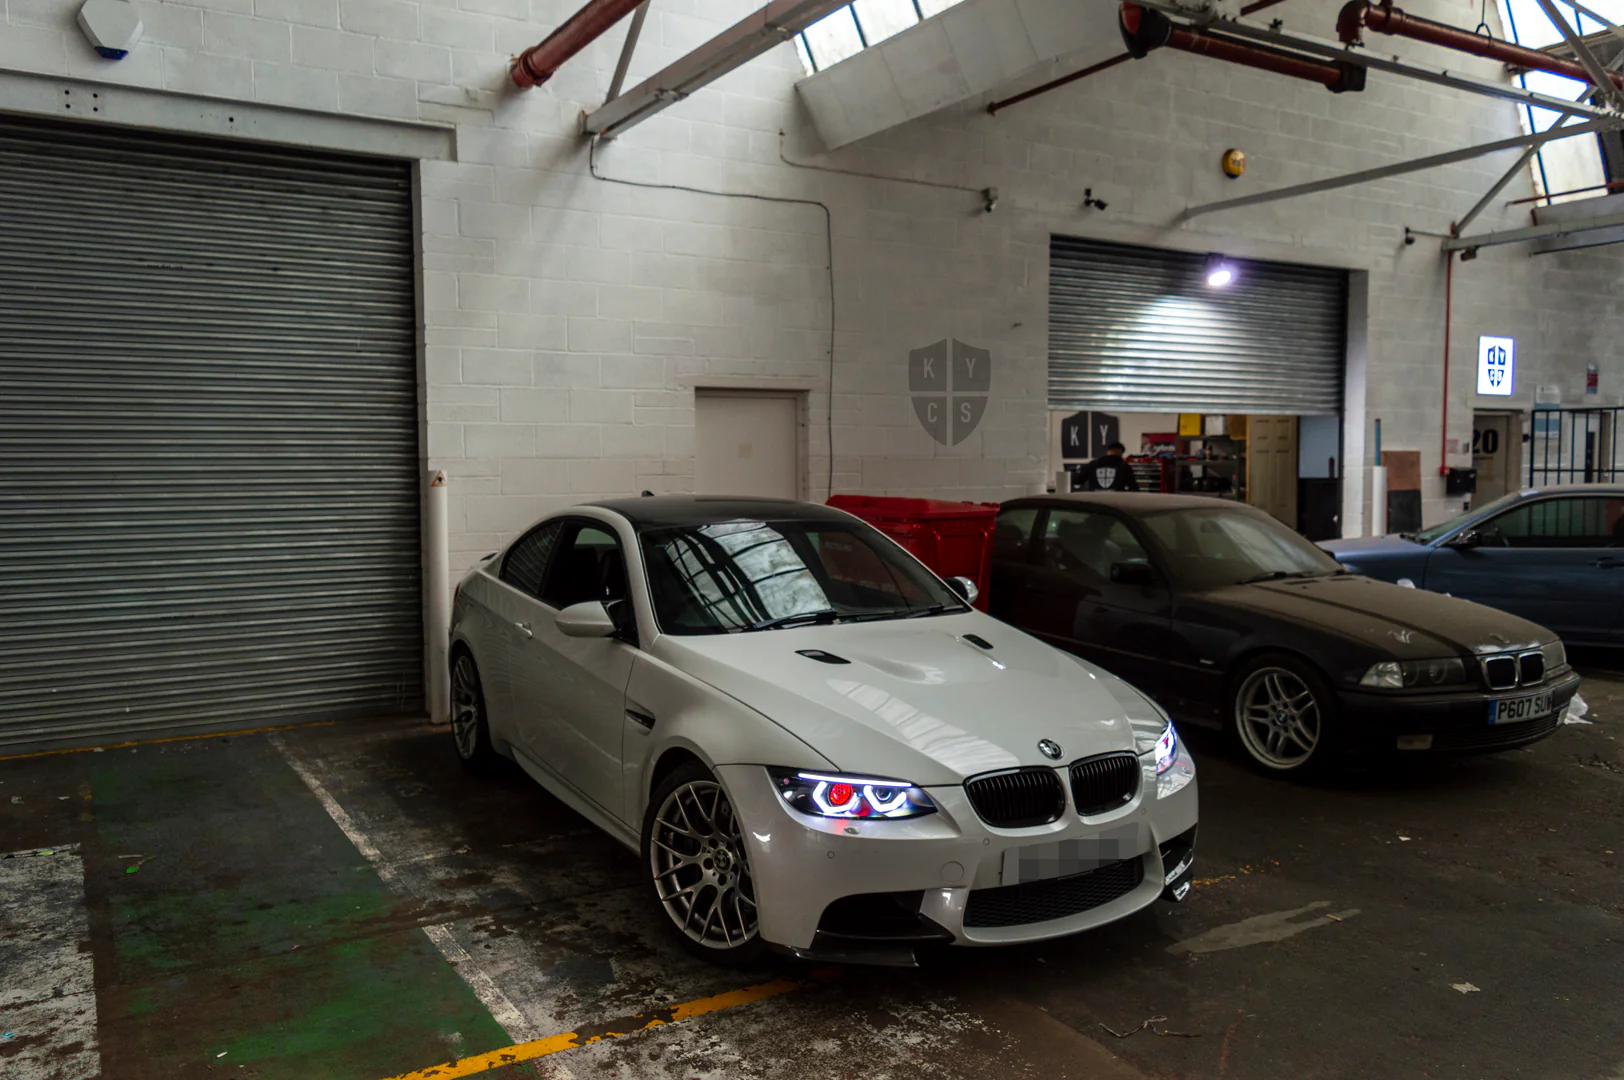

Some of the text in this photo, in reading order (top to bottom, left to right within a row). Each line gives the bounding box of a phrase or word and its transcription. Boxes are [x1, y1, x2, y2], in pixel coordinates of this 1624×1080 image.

[1070, 424, 1108, 446] K Y
[1473, 428, 1498, 454] 20
[1497, 698, 1532, 720] P607
